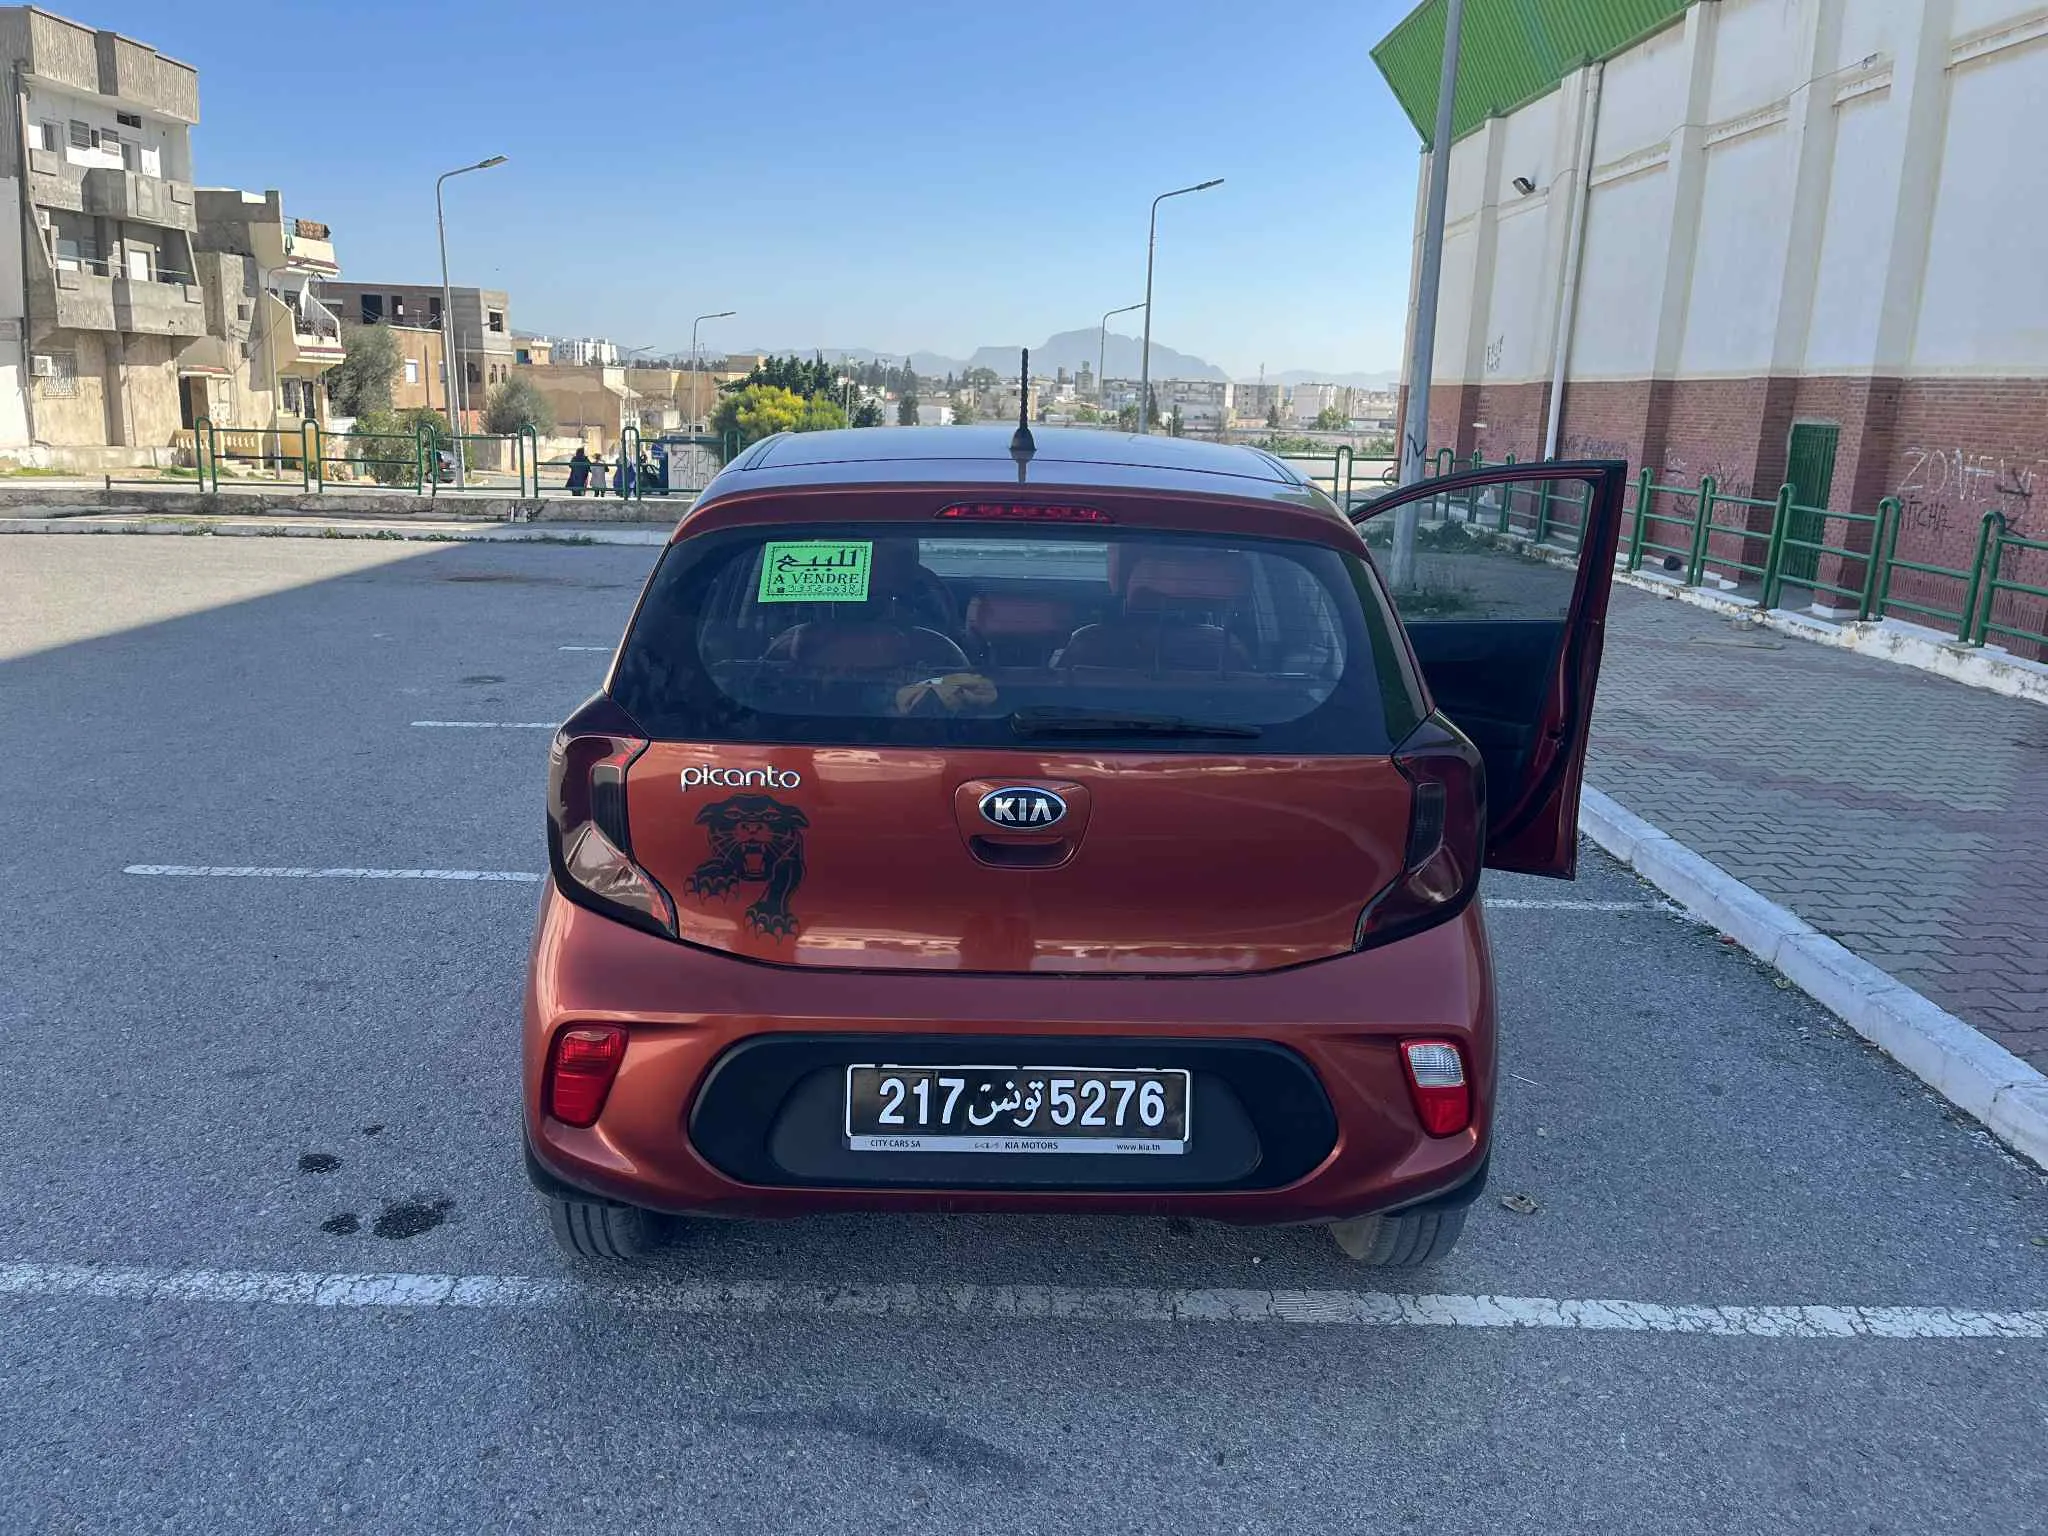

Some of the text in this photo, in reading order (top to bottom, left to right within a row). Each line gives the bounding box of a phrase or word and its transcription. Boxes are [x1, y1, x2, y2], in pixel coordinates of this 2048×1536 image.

[776, 548, 857, 572] للبيع
[773, 572, 860, 585] A VENDRE
[680, 764, 802, 792] picanto
[993, 797, 1053, 822] KIA
[877, 1077, 1165, 1127] 217 تونس 5276
[870, 1139, 921, 1148] CITY CARS SA
[1004, 1141, 1019, 1150] KIA
[1021, 1141, 1058, 1150] MOTORS
[1116, 1142, 1161, 1151] www.kia.tn
